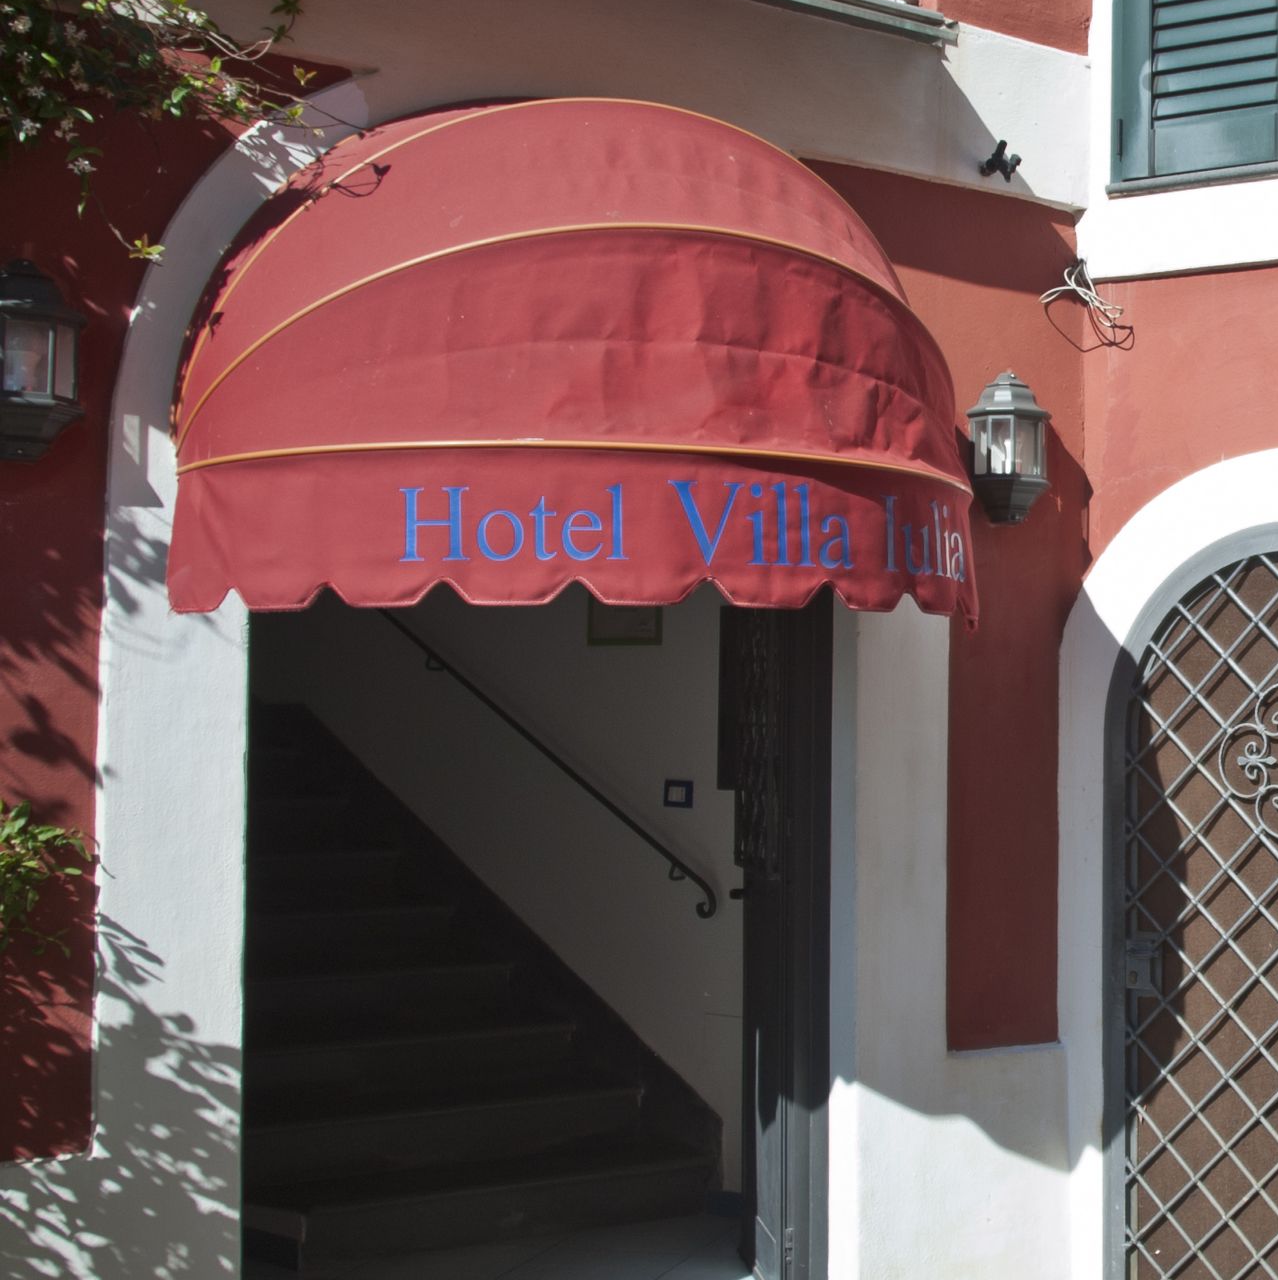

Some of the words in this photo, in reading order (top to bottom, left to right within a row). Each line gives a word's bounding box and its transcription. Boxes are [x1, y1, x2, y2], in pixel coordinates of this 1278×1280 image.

[398, 482, 630, 563] Hotel
[667, 479, 856, 570] Villa
[880, 495, 966, 583] Iulia
